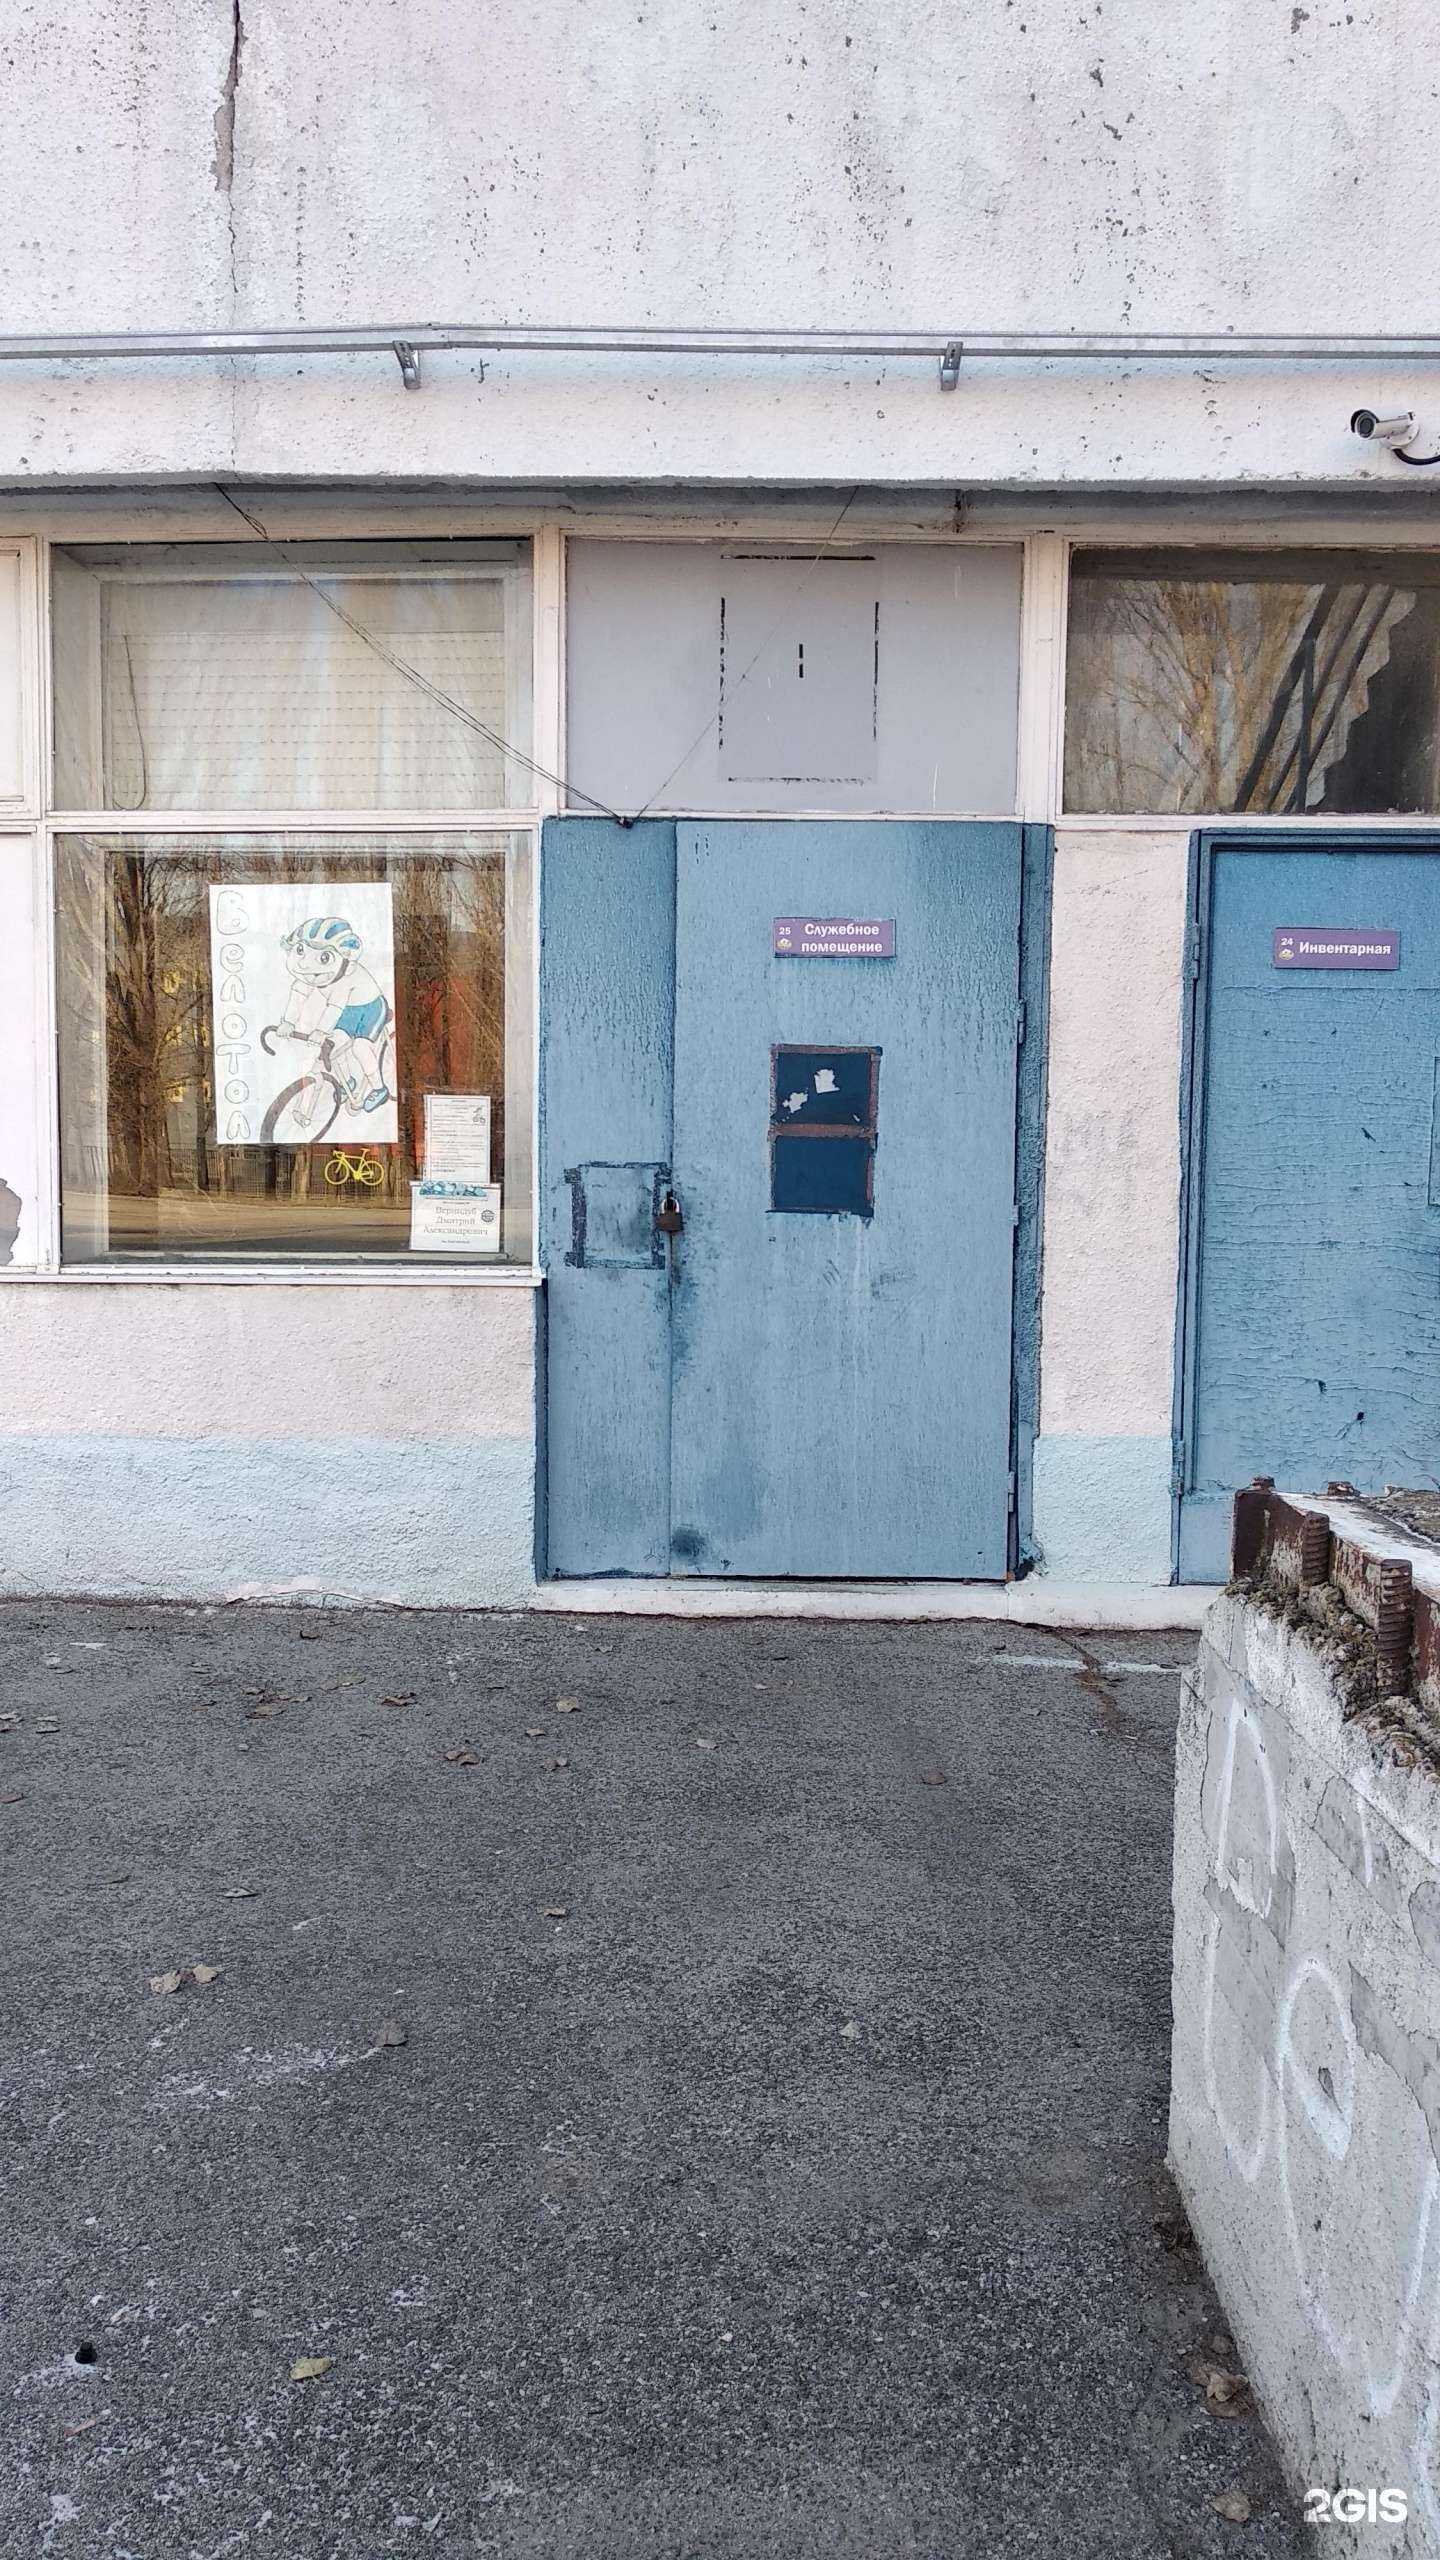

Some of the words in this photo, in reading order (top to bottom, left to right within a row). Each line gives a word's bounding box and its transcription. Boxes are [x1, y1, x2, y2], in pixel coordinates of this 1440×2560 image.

[779, 926, 791, 935] 25
[804, 923, 880, 937] Служебное
[1281, 937, 1293, 946] 24
[801, 943, 883, 953] помещение
[1299, 941, 1391, 956] Инвентарная
